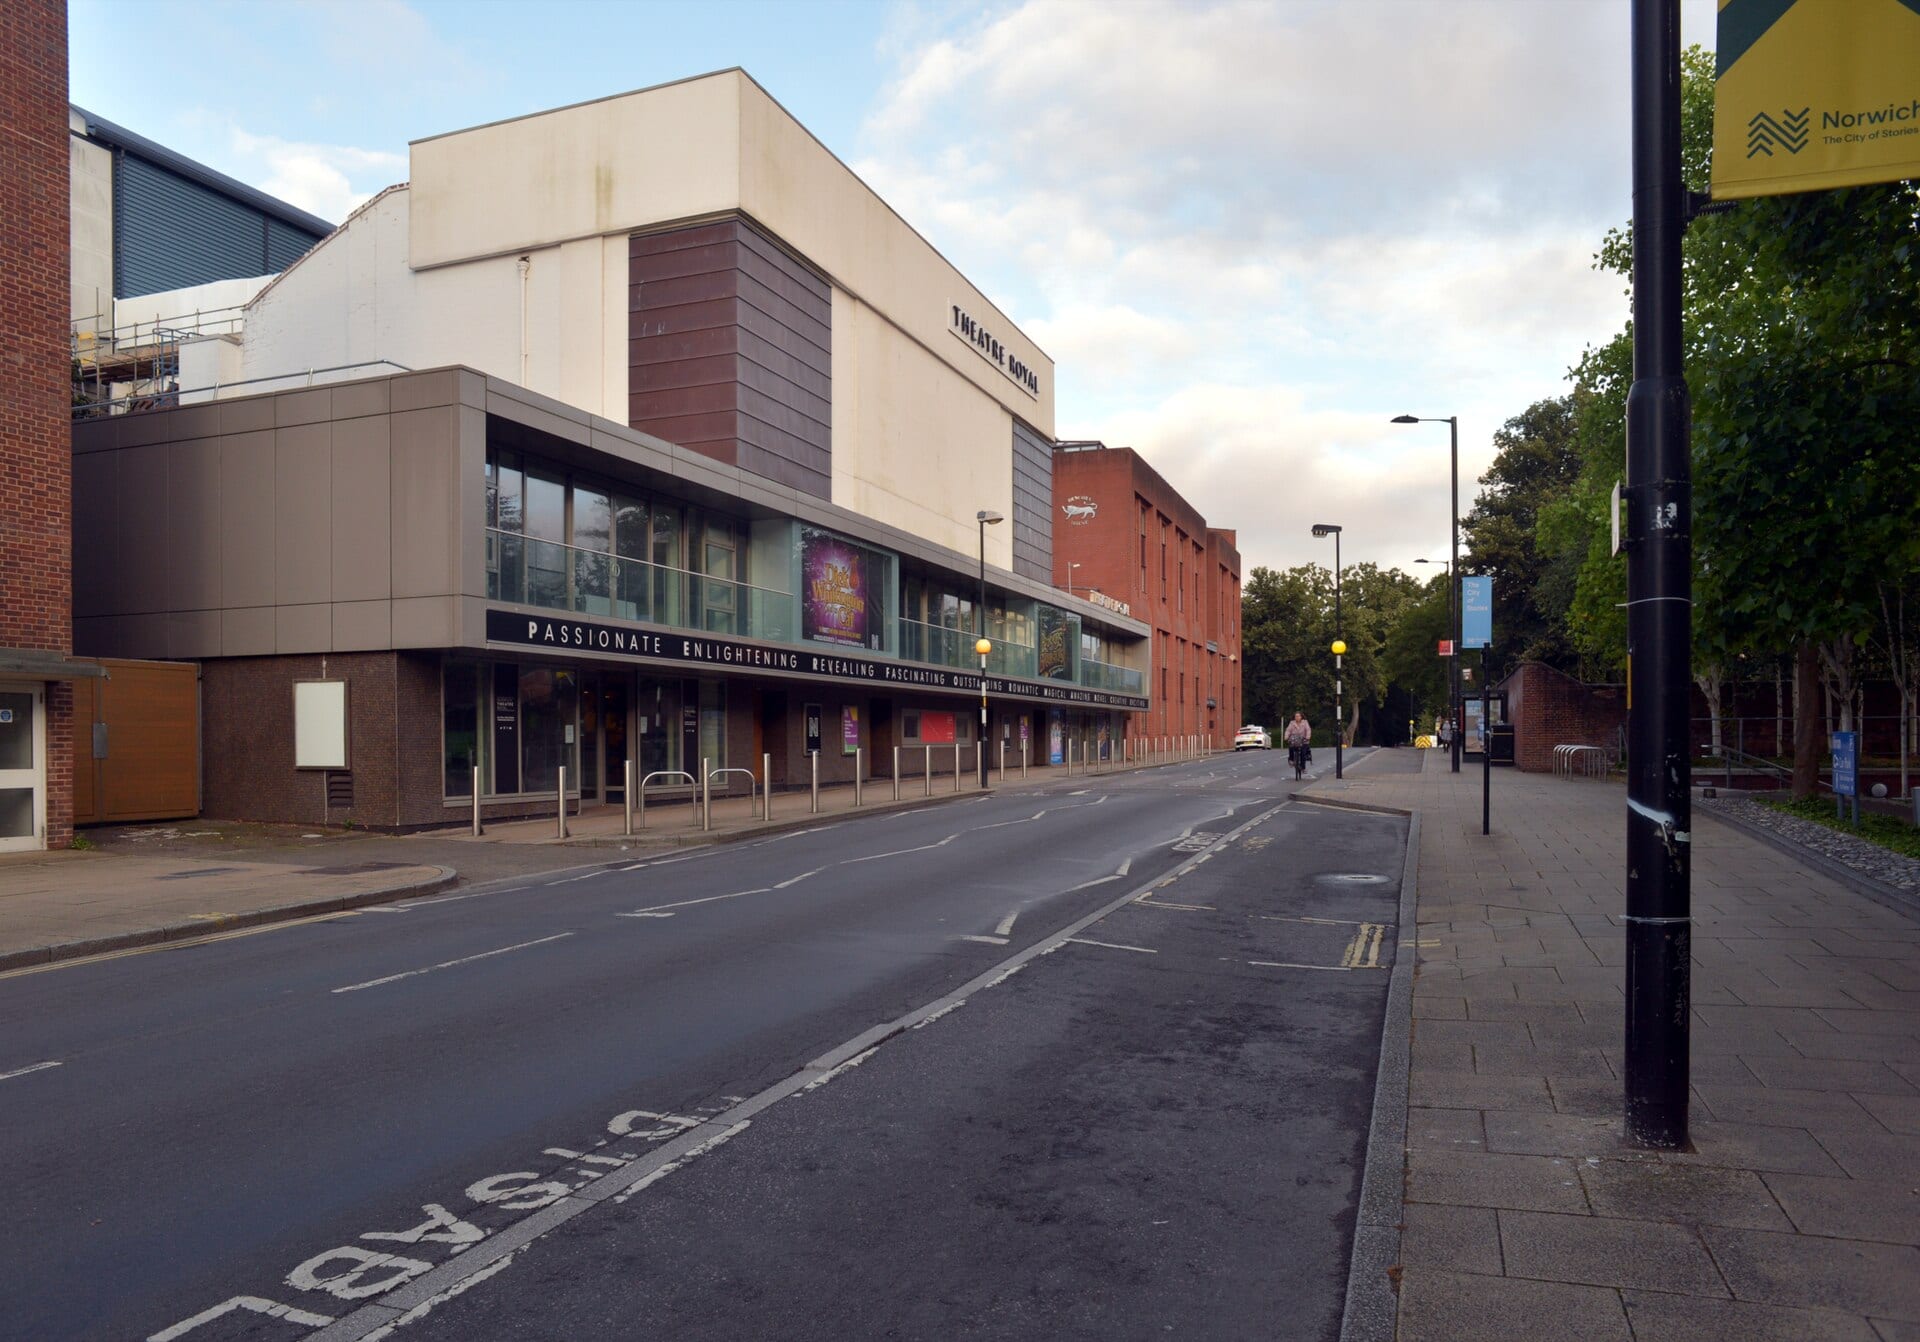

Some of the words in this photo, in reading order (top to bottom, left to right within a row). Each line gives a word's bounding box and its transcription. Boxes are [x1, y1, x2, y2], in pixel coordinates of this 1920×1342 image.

[1823, 100, 1920, 129] Norwich
[1823, 136, 1842, 145] The
[1844, 133, 1865, 143] City
[1868, 131, 1880, 139] of
[1882, 127, 1919, 138] Stories
[952, 305, 1005, 366] THEATRE
[1009, 354, 1039, 394] ROYAL
[528, 621, 661, 654] PASSIONATE
[684, 641, 797, 669] ENLIGHTENING
[812, 657, 874, 677] REVEALING
[886, 666, 945, 685] FASCINATING
[953, 677, 1002, 692] OUTSTADING
[1009, 682, 1038, 696] ROMANTIC
[1044, 687, 1066, 699] MAGICAL
